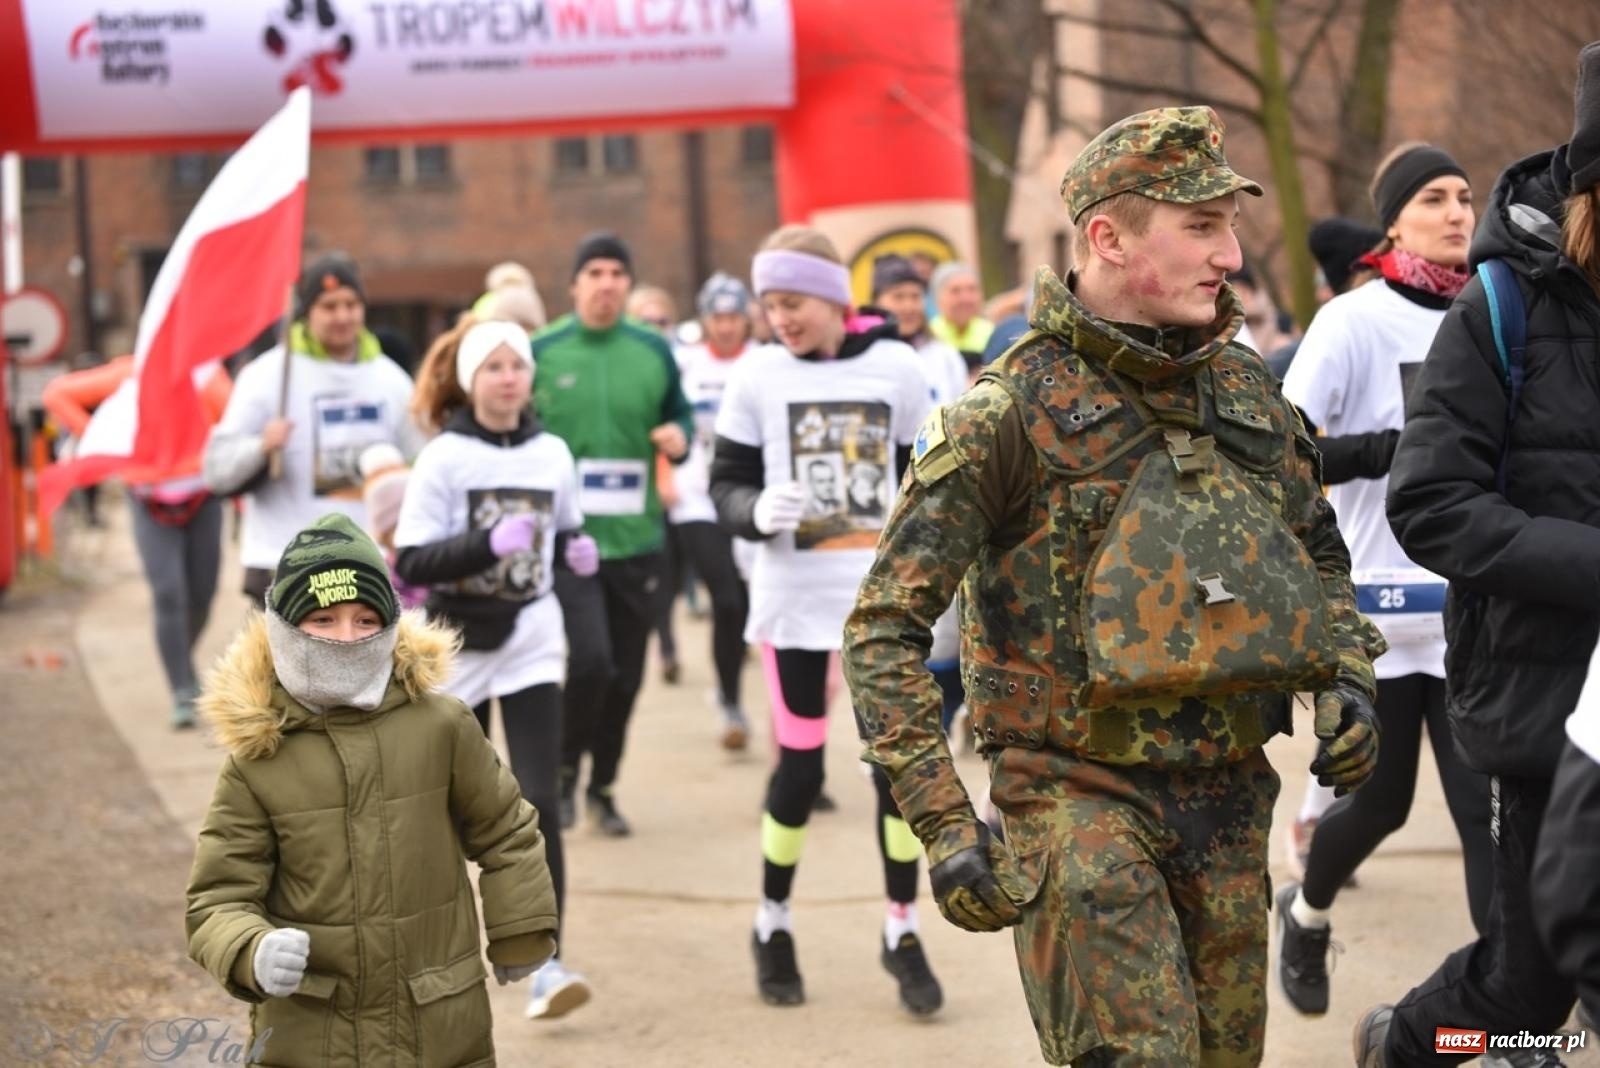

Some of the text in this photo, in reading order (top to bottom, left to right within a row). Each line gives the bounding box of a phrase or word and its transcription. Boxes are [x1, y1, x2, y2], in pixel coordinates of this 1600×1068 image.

[308, 568, 358, 594] JURASSIC
[315, 585, 358, 608] WORLD
[1379, 587, 1406, 608] 25
